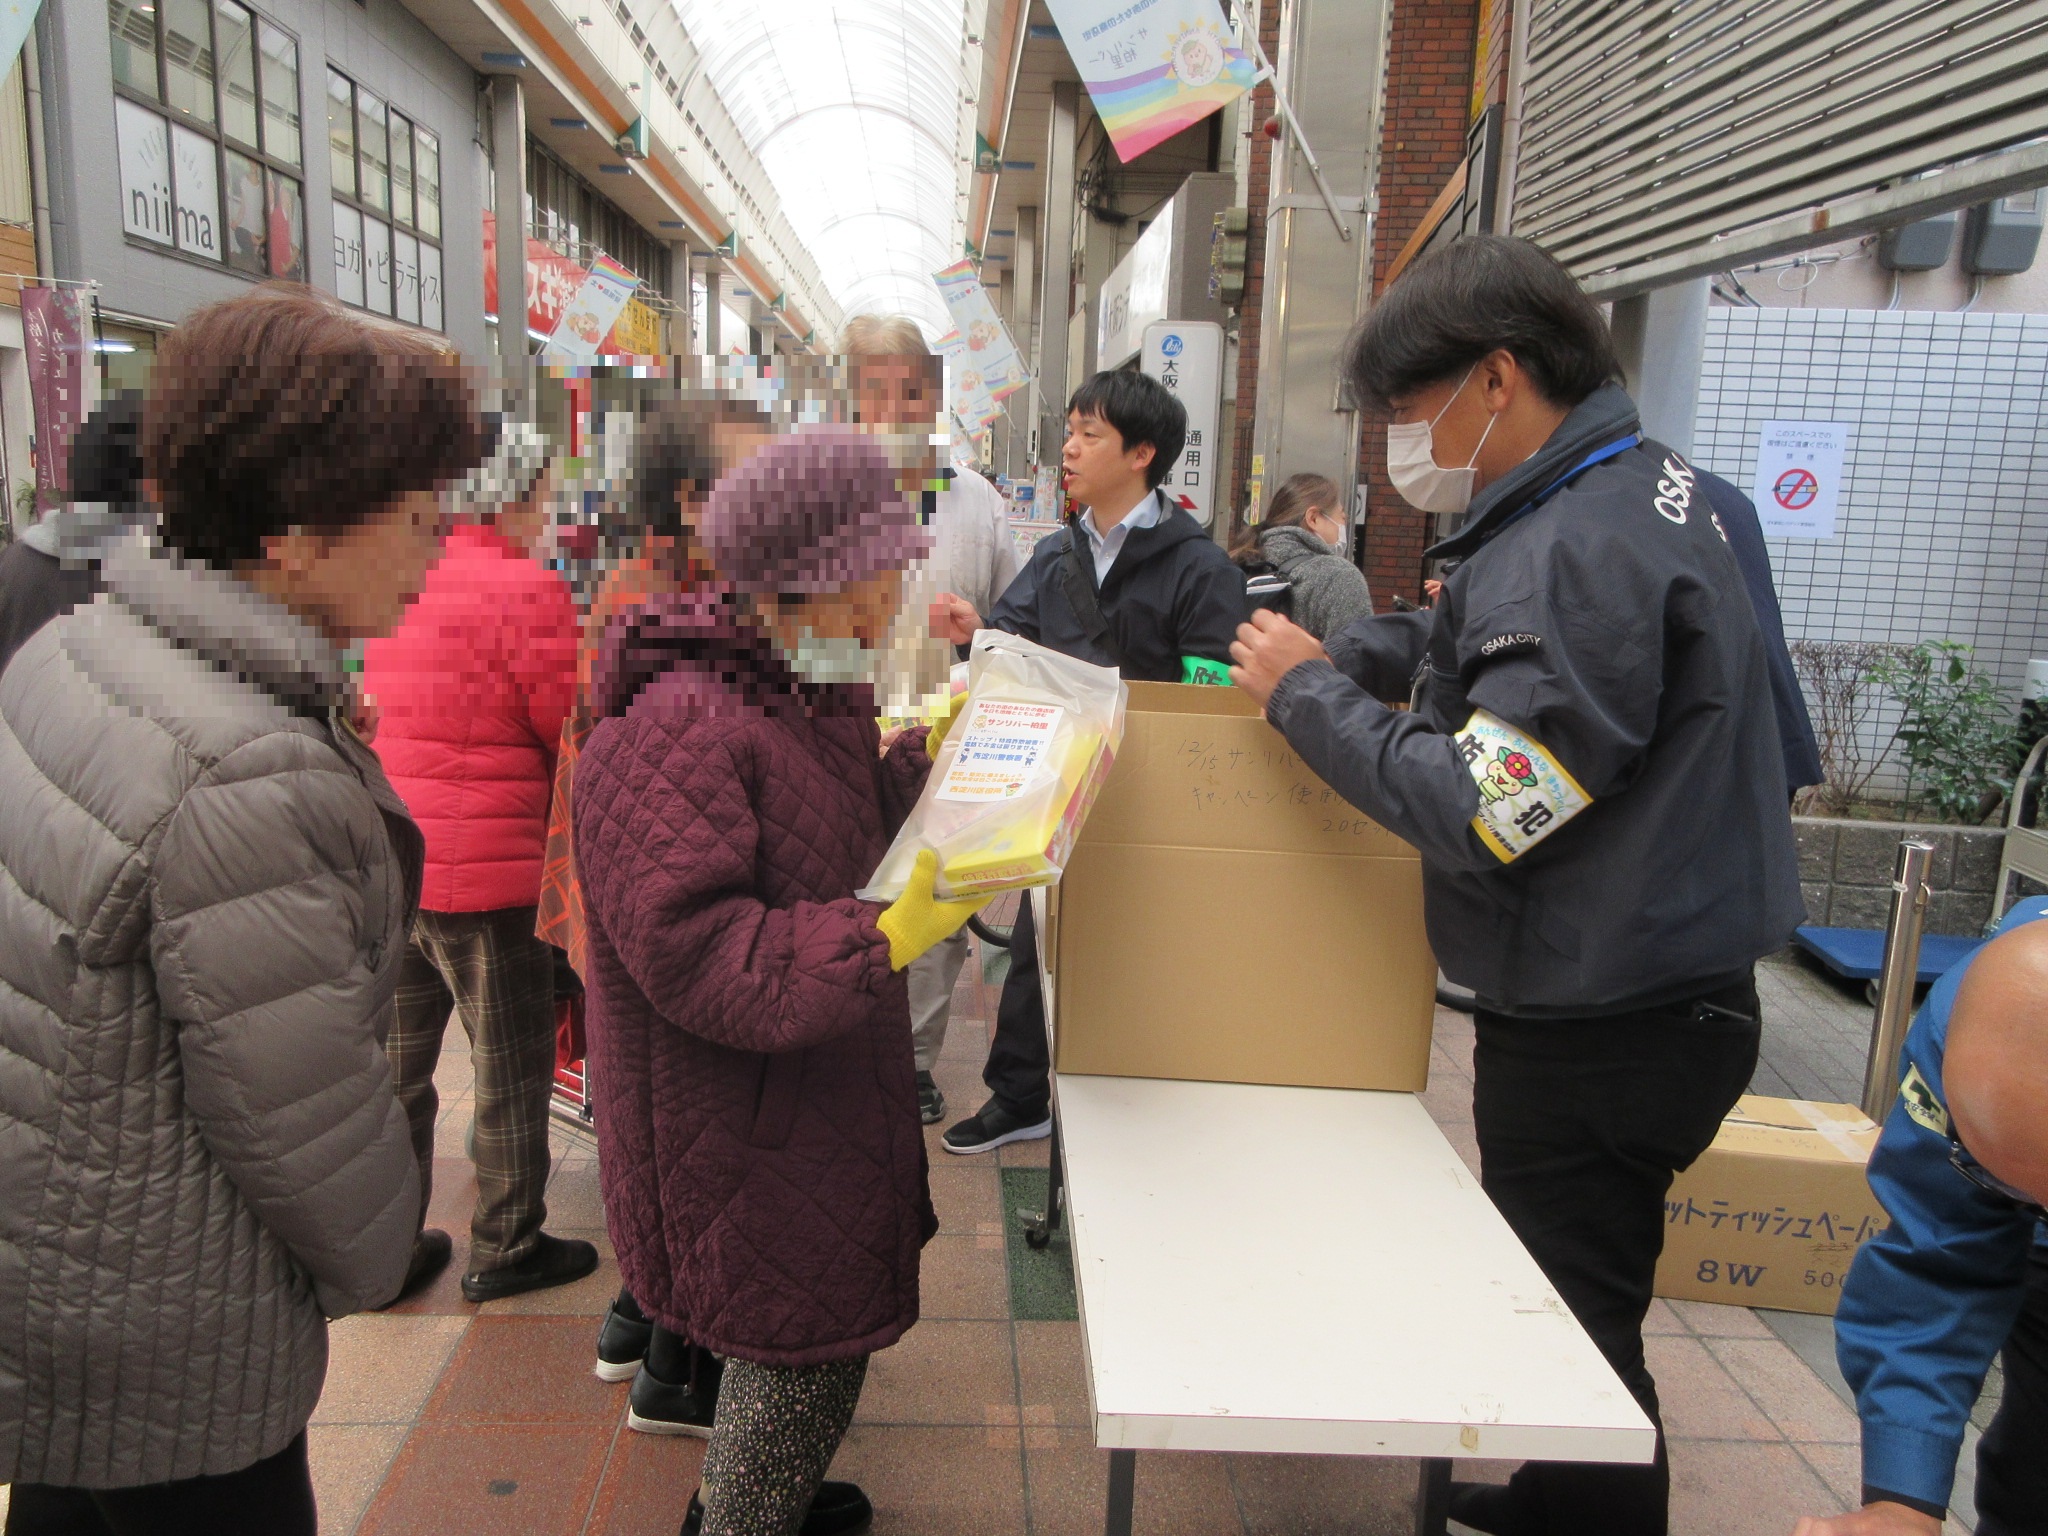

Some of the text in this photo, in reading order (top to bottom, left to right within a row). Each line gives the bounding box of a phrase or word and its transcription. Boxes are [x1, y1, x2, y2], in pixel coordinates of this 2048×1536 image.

[334, 236, 440, 304] ヨガ・ピラティス
[1184, 430, 1202, 487] 通用口
[1481, 633, 1542, 656] OSAKA CITY
[1696, 1259, 1768, 1288] 8W
